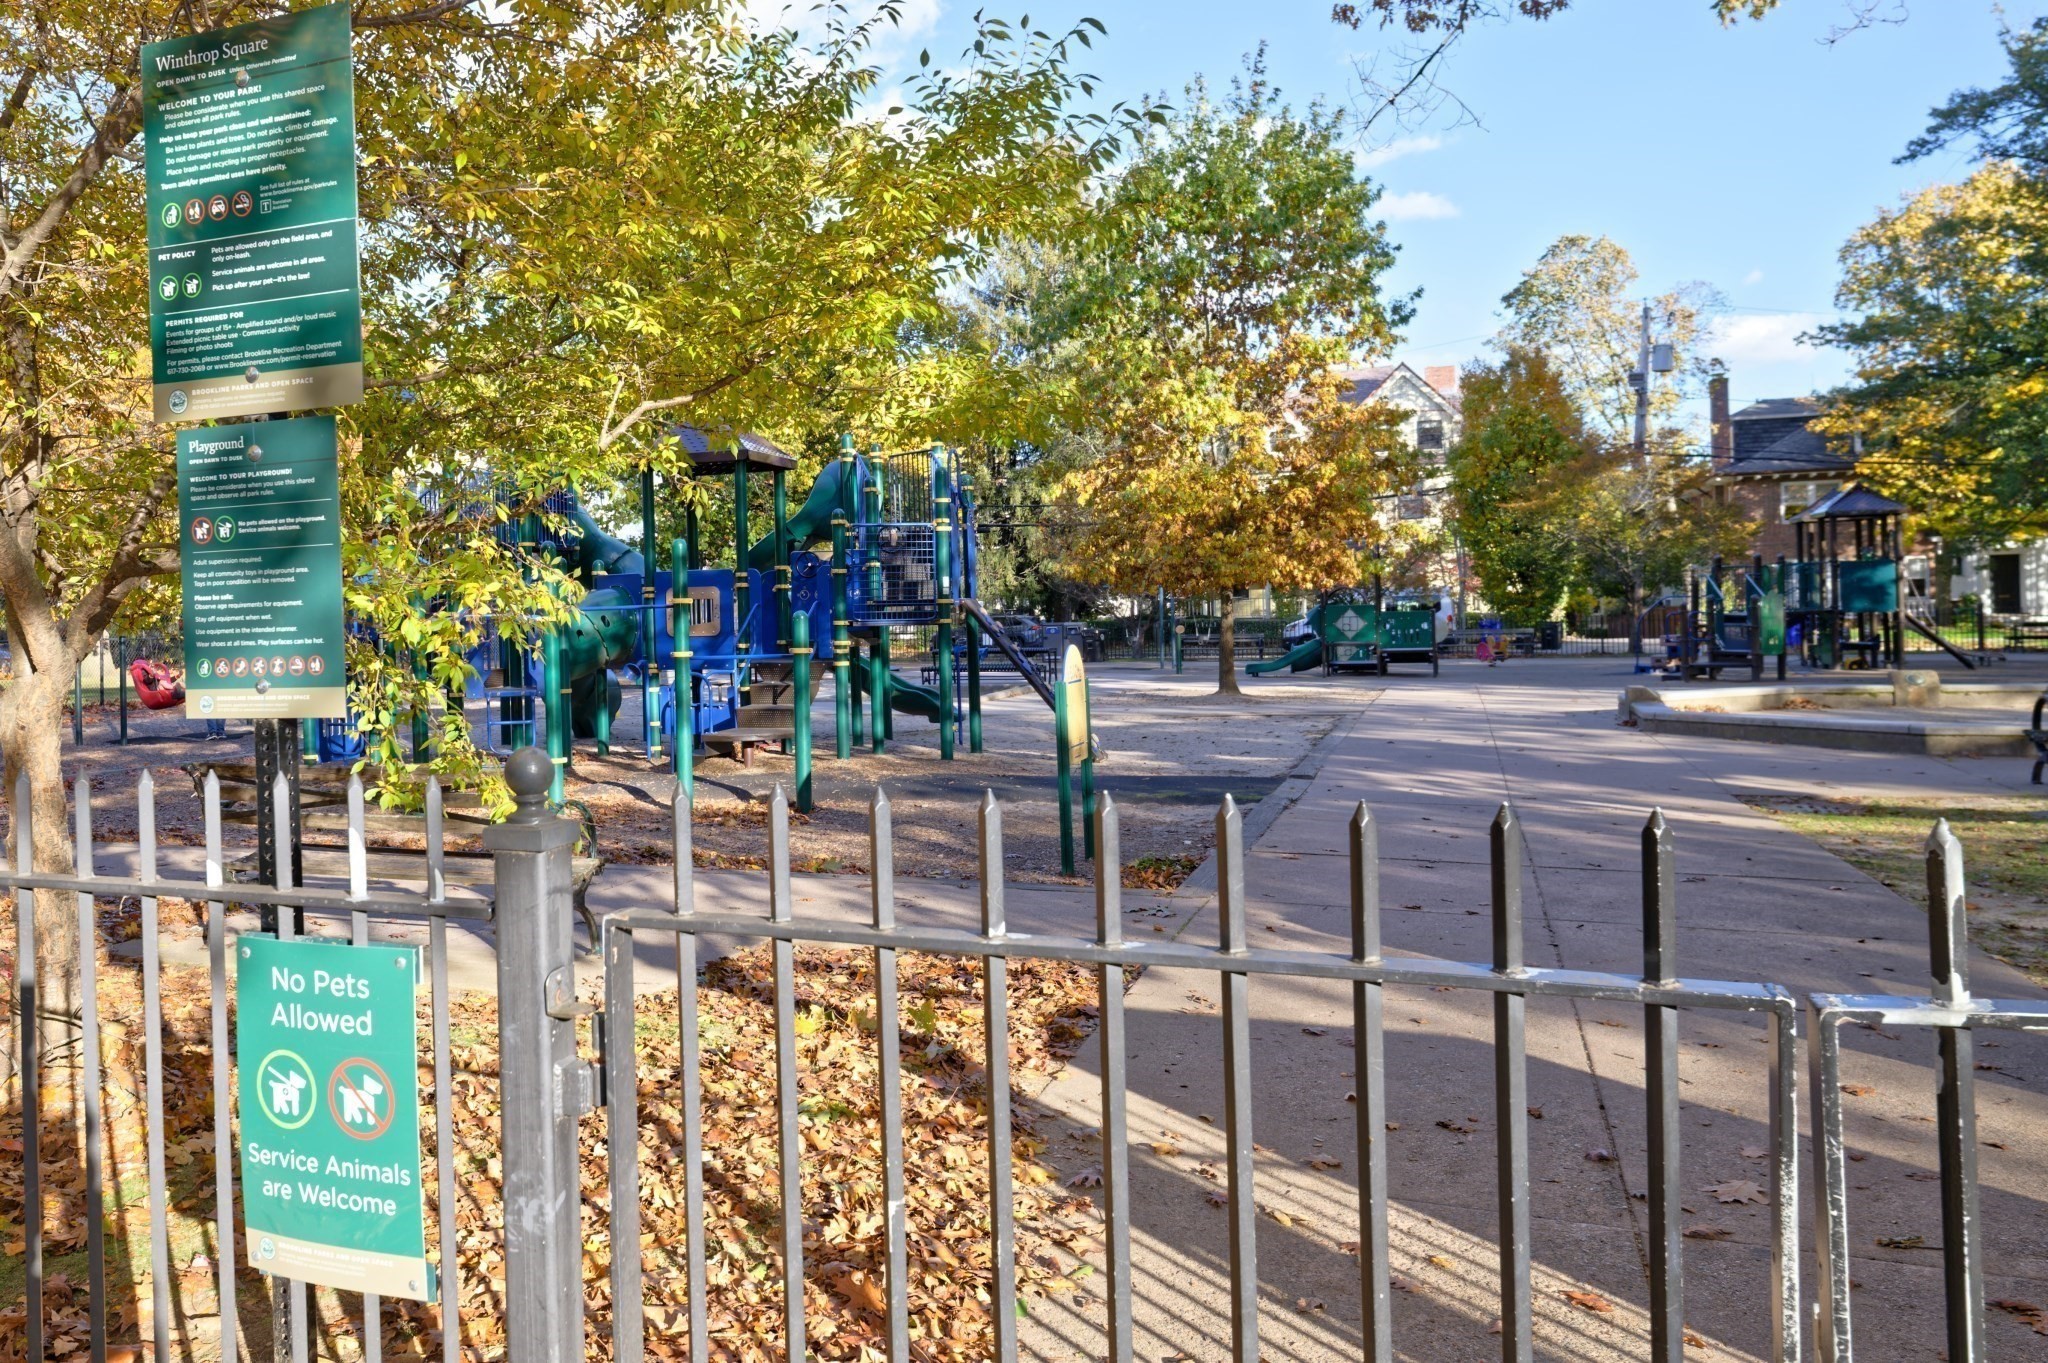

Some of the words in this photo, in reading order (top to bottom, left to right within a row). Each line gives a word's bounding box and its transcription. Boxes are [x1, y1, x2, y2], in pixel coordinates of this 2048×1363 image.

[156, 50, 219, 71] Winthrop
[223, 39, 269, 60] Square
[156, 79, 175, 89] OPEN
[175, 74, 196, 85] DAWN
[197, 72, 207, 81] TO
[208, 68, 227, 78] DUSK
[271, 53, 297, 65] Permitted
[158, 97, 198, 112] WELCOME
[199, 94, 211, 104] TO
[212, 89, 236, 102] YOUR
[237, 84, 262, 97] PARK!
[164, 113, 184, 122] Please
[184, 110, 193, 118] be
[194, 103, 228, 116] considerate
[229, 100, 246, 109] when
[247, 98, 259, 107] you
[259, 95, 271, 103] use
[272, 92, 284, 101] this
[284, 87, 306, 98] shared
[306, 85, 325, 95] space
[165, 121, 176, 130] and
[177, 118, 201, 128] observe
[210, 112, 224, 123] park
[225, 110, 241, 118] rules.
[165, 147, 174, 155] Be
[175, 143, 188, 153] kind
[196, 139, 215, 150] plants
[216, 136, 228, 145] and
[228, 135, 245, 143] trees.
[246, 131, 256, 140] Do
[257, 129, 268, 138] not
[269, 126, 284, 137] pick,
[284, 122, 302, 132] climb
[311, 117, 339, 128] damage.
[166, 158, 175, 166] Do
[176, 156, 186, 164] not
[187, 152, 211, 162] damage
[220, 147, 241, 156] misuse
[242, 142, 256, 153] park
[257, 138, 284, 151] property
[293, 130, 329, 144] equipment.
[166, 169, 182, 177] Place
[183, 164, 199, 174] trash
[199, 162, 211, 171] and
[212, 158, 239, 169] recycling
[240, 156, 246, 164] in
[247, 153, 268, 164] proper
[269, 146, 307, 159] receptacles.
[211, 246, 224, 255] Pets
[235, 240, 257, 251] allowed
[258, 239, 270, 248] only
[280, 236, 290, 244] the
[291, 233, 304, 243] field
[320, 229, 333, 238] and
[158, 253, 171, 262] PET
[171, 249, 196, 260] POLICY
[212, 255, 224, 263] only
[225, 251, 252, 261] on-leash.
[212, 268, 233, 278] Service
[233, 265, 255, 274] animals
[266, 261, 292, 270] welcome
[293, 258, 299, 266] in
[308, 256, 326, 264] areas.
[165, 317, 193, 328] PERMITS
[194, 313, 229, 324] REQUIRED
[229, 311, 244, 320] FOR
[166, 330, 185, 338] Events
[194, 327, 214, 336] groups
[236, 320, 264, 330] Amplified
[265, 317, 283, 326] sound
[284, 315, 303, 324] and/or
[304, 313, 318, 321] loud
[319, 311, 337, 319] music
[166, 337, 193, 347] Extended
[194, 335, 211, 345] picnic
[212, 333, 227, 341] table
[242, 327, 277, 338] Commercial
[278, 324, 300, 333] activity
[166, 347, 188, 356] Filming
[196, 344, 213, 353] photo
[214, 342, 234, 350] shoots
[178, 358, 201, 367] permits,
[201, 356, 220, 364] please
[221, 352, 243, 361] contact
[244, 349, 272, 358] Brookline
[273, 345, 305, 355] Recreation
[306, 340, 342, 352] Department
[191, 386, 230, 396] BROOKLINE
[231, 383, 254, 392] PARKS
[255, 381, 270, 390] AND
[271, 379, 290, 388] OPEN
[291, 376, 314, 386] SPACE
[188, 436, 244, 455] Playground
[190, 474, 218, 482] WELCOME
[228, 472, 247, 480] YOUR
[247, 468, 293, 478] PLAYGROUND!
[216, 483, 247, 491] considerate
[296, 477, 316, 485] shared
[247, 490, 259, 498] park
[208, 558, 238, 566] supervision
[228, 602, 263, 610] requirements
[271, 966, 305, 993] No
[313, 969, 370, 999] Pets
[270, 1002, 372, 1036] Allowed
[248, 1142, 319, 1174] Service
[325, 1155, 411, 1186] Animals
[262, 1178, 292, 1200] are
[298, 1182, 397, 1217] Welcome
